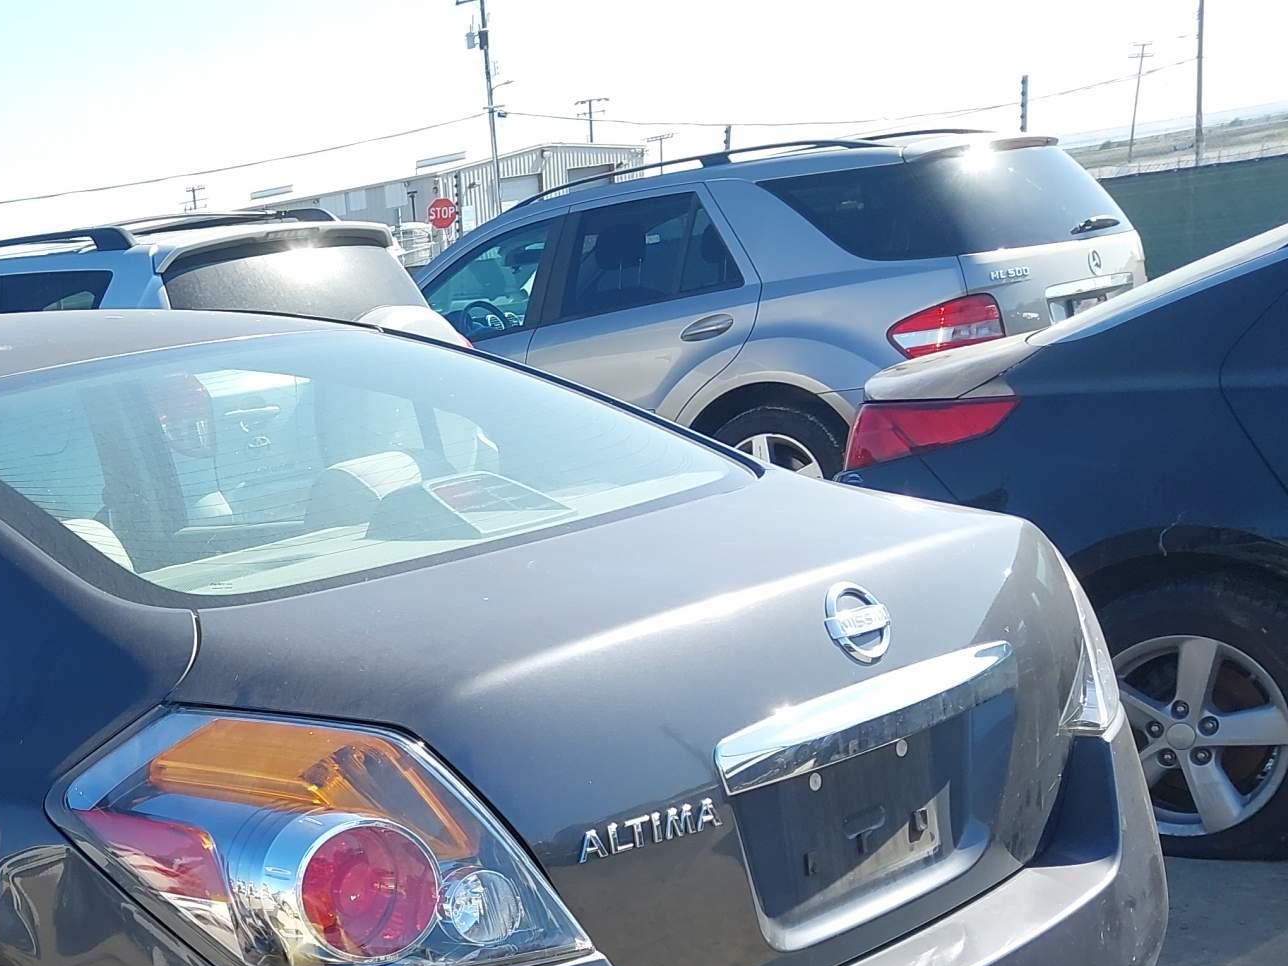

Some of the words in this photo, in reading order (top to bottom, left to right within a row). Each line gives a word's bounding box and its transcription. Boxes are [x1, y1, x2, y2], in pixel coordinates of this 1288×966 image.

[429, 206, 455, 219] STOP
[1007, 266, 1030, 278] 500
[579, 797, 723, 863] ALTIMA
